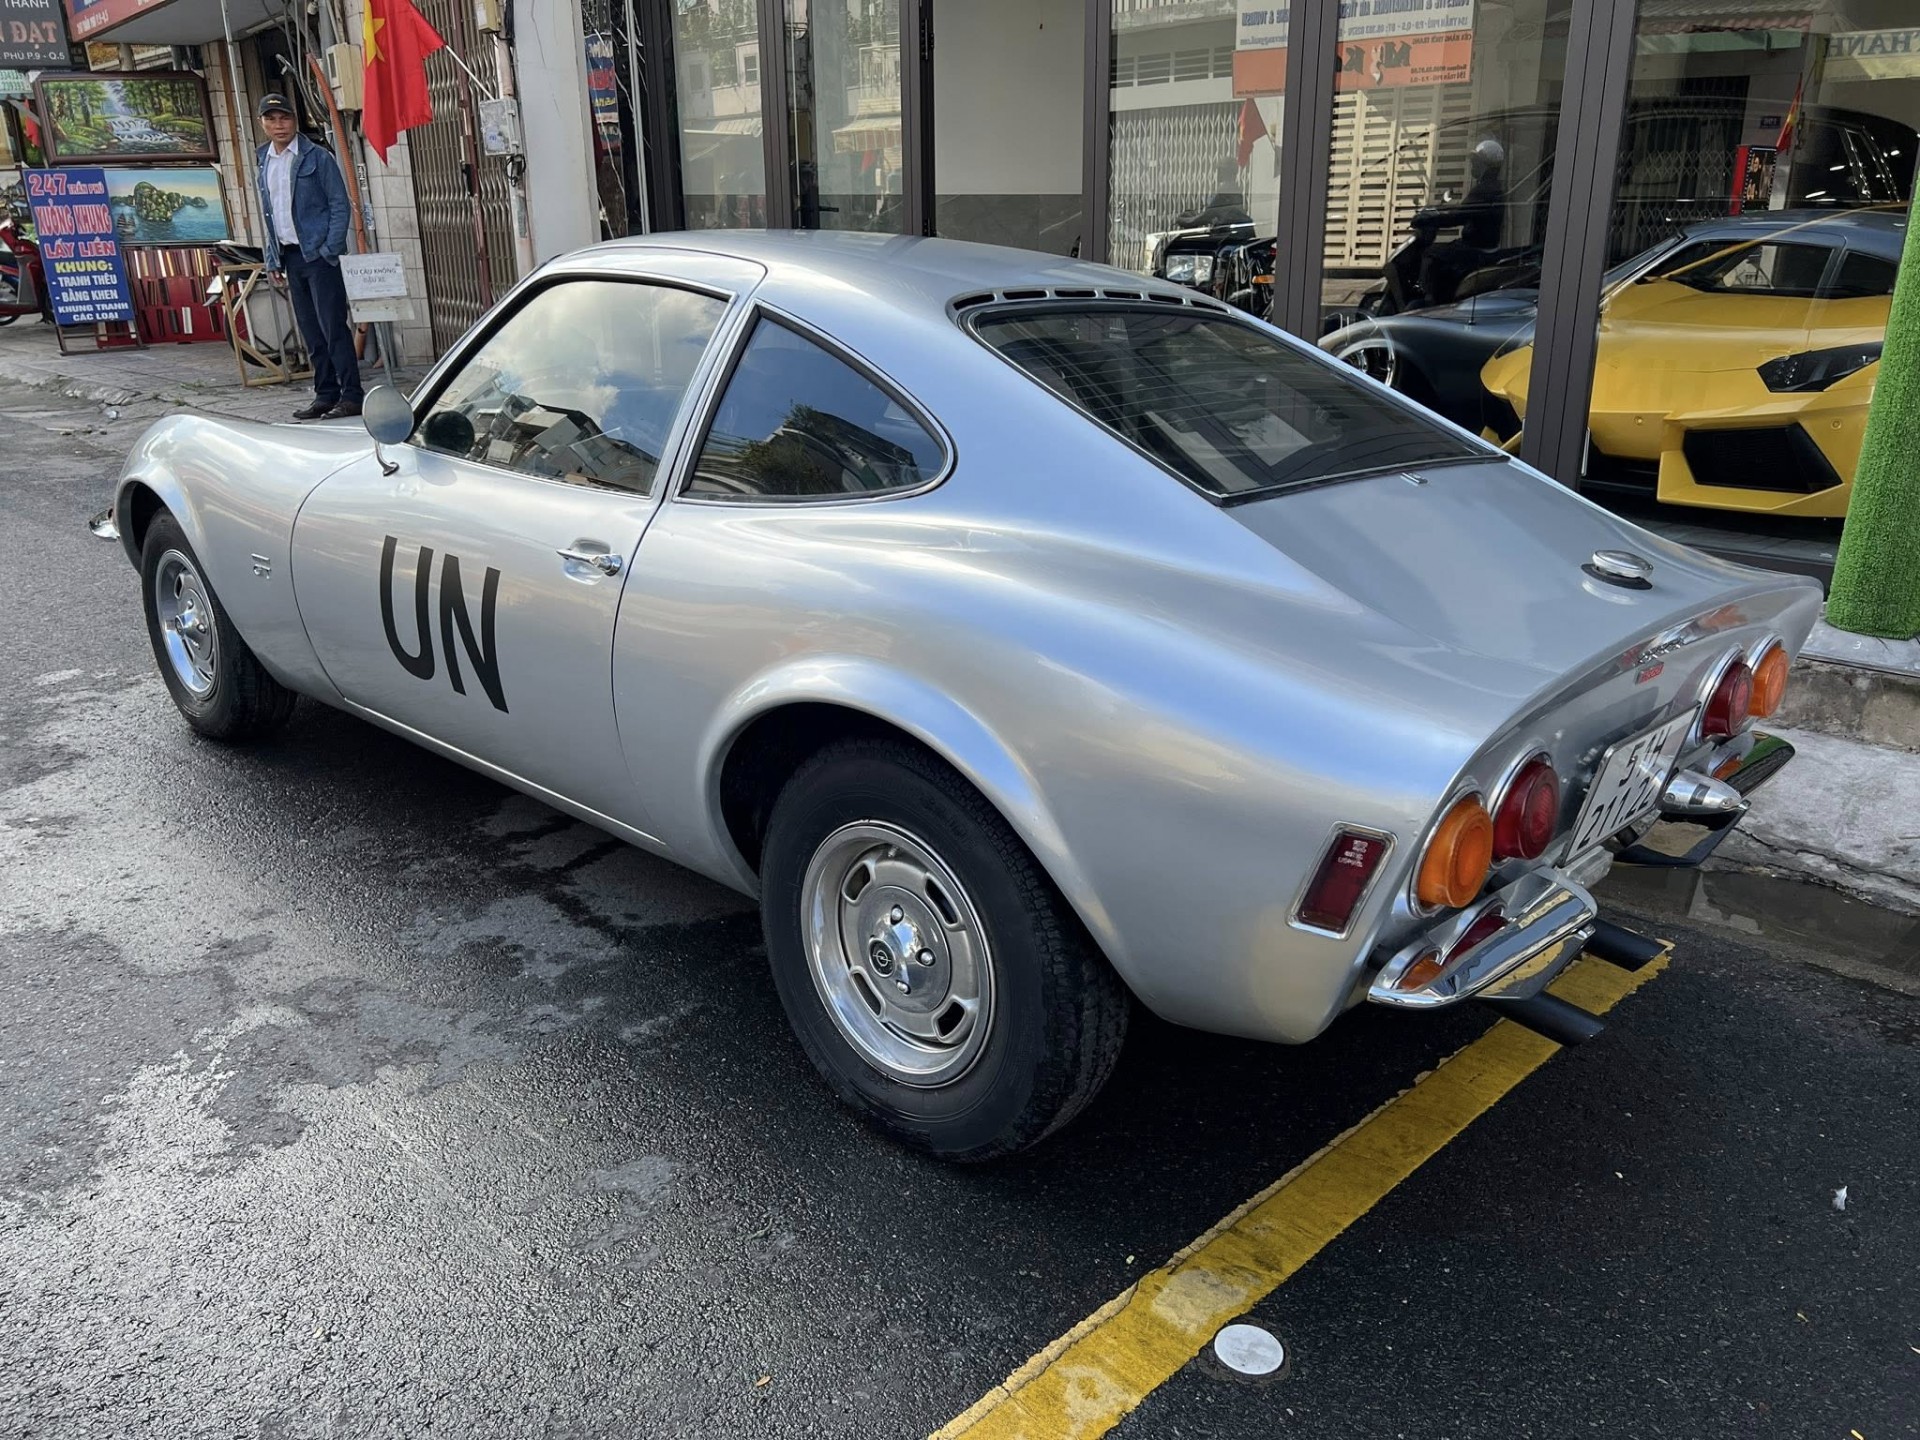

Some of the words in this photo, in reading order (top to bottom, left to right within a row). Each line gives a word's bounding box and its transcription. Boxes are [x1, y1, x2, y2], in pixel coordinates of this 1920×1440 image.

[9, 20, 57, 49] ĐẠT
[49, 51, 65, 61] Q.5
[28, 173, 67, 196] 247
[72, 203, 113, 234] KHUNG
[54, 260, 113, 273] KHUNG:
[58, 275, 91, 287] TRANH
[91, 272, 118, 286] THÊU
[90, 289, 118, 301] KHEN
[58, 304, 94, 313] KHUNG
[95, 302, 129, 311] TRANH
[380, 535, 509, 714] UN
